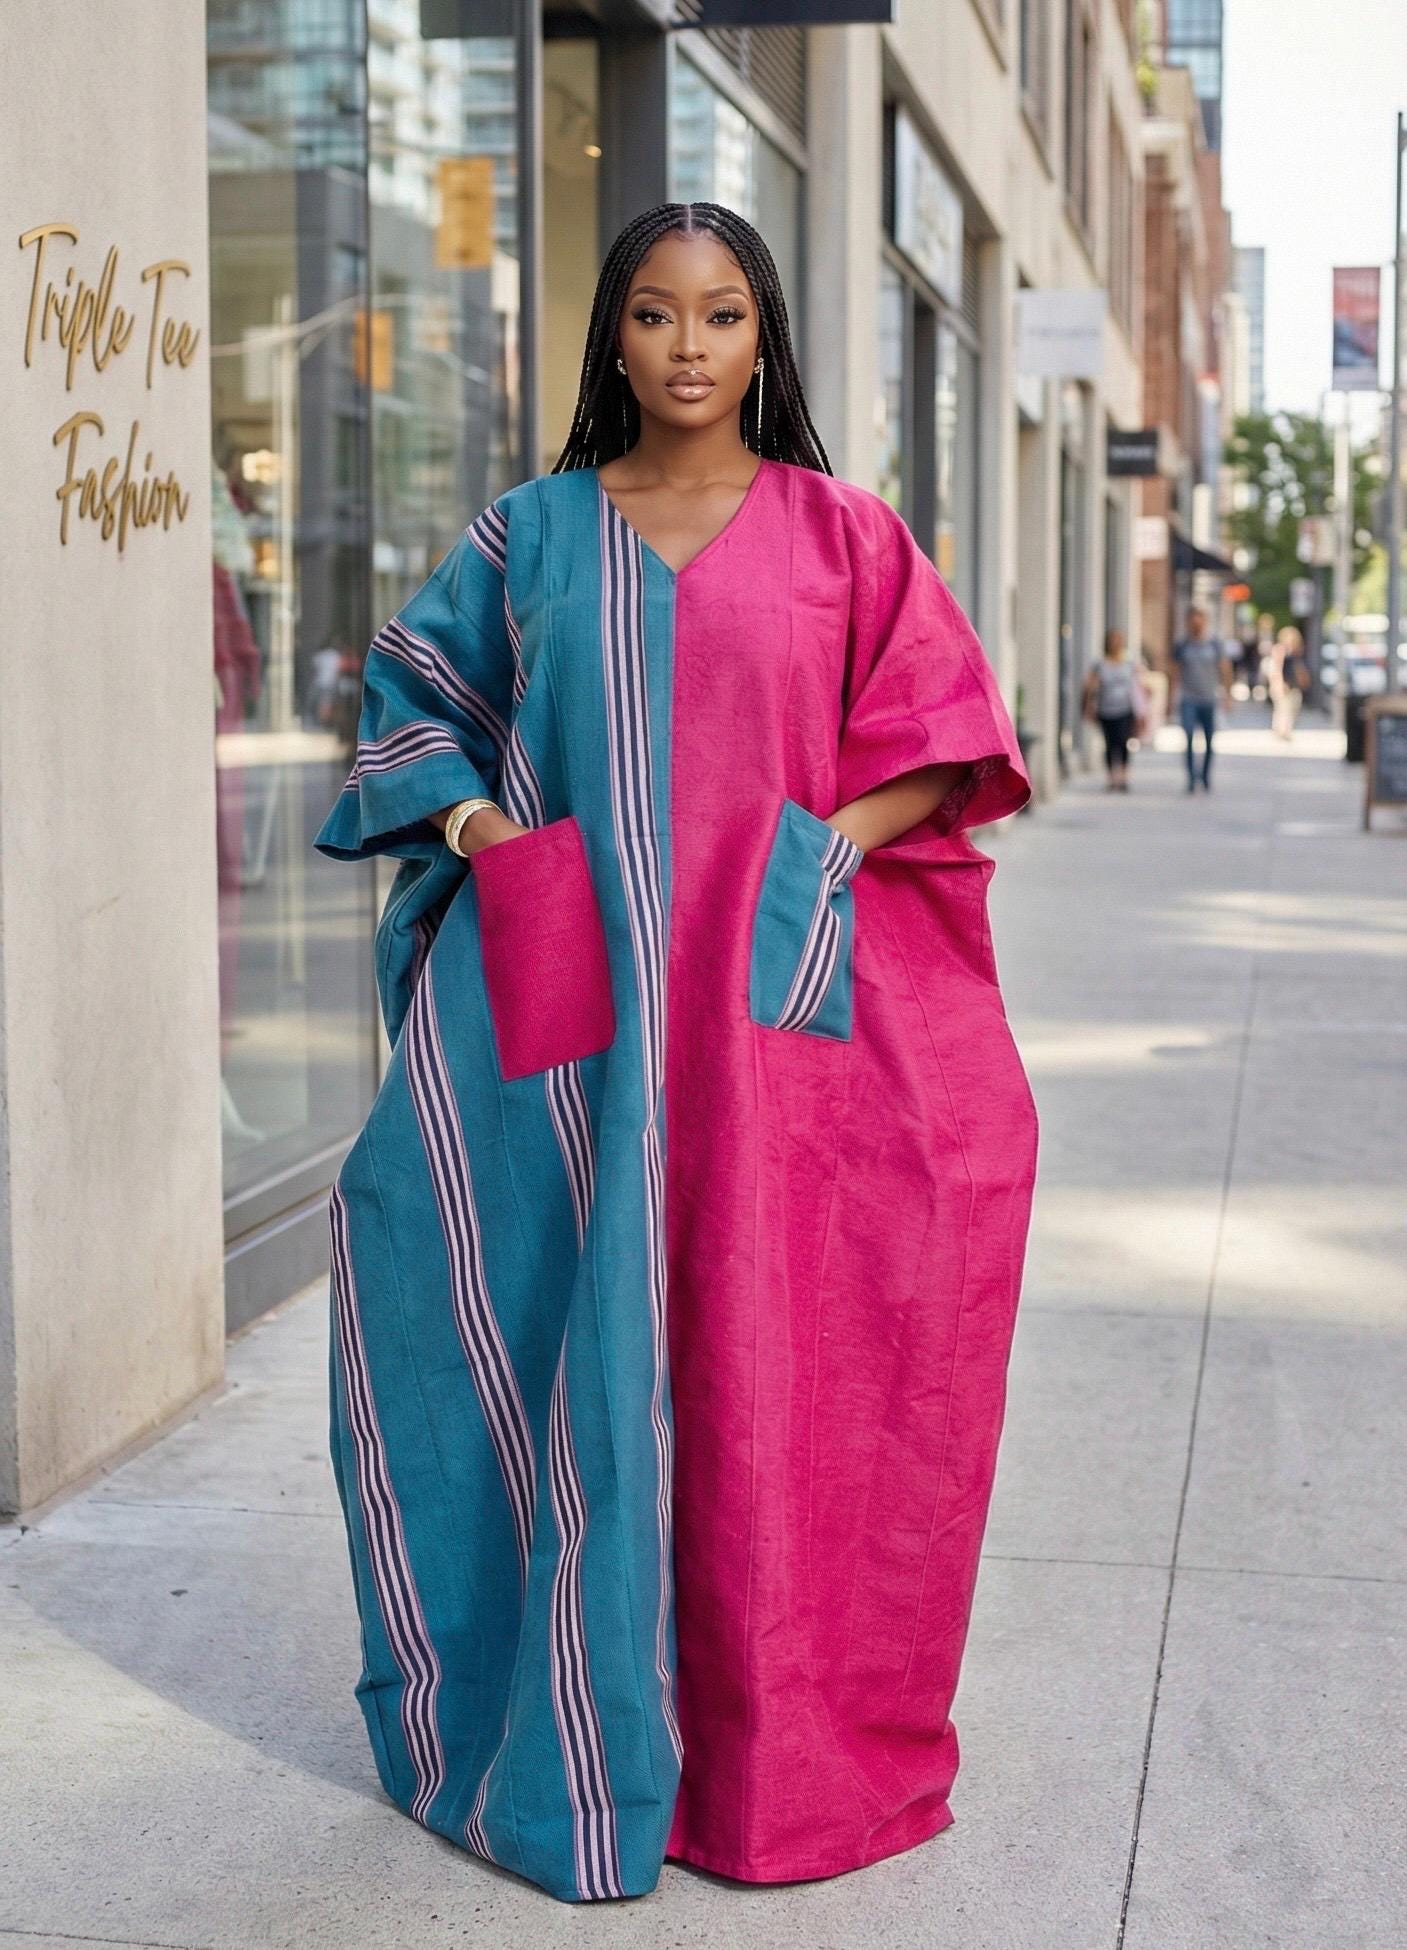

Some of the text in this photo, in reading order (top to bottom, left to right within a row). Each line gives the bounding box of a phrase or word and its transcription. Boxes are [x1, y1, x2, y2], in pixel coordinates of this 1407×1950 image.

[19, 222, 200, 392] Triple Tee
[53, 411, 190, 553] Fashion
